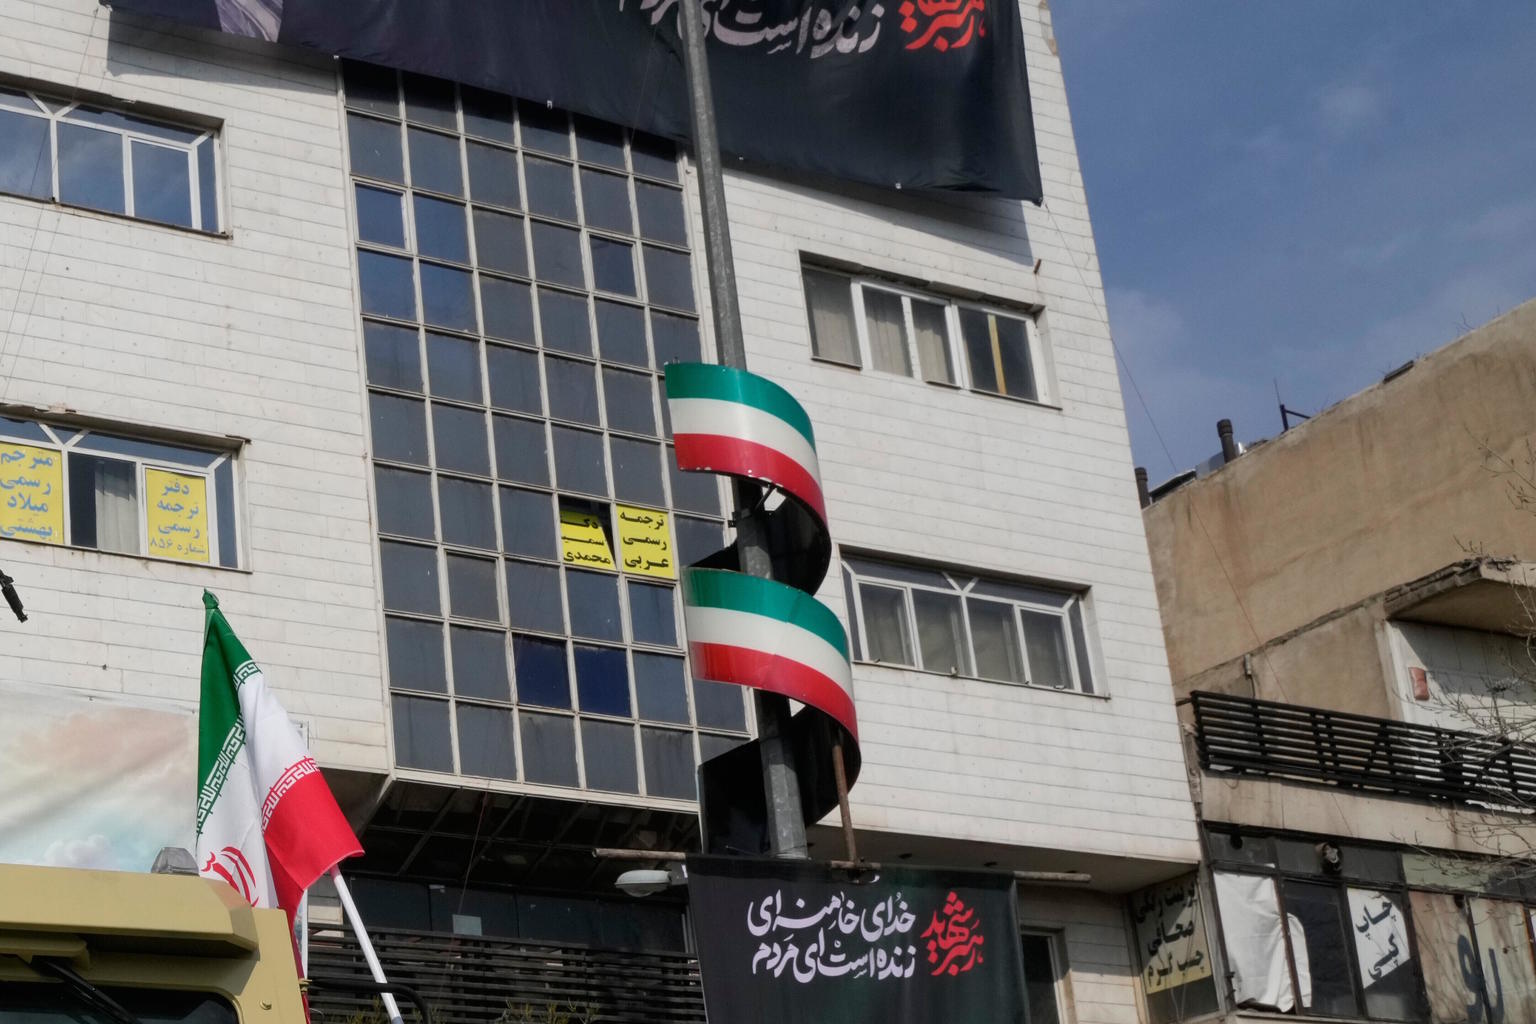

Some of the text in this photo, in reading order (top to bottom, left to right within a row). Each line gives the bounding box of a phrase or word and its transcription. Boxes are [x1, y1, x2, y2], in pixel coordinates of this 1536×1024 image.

[713, 3, 812, 55] است
[810, 2, 885, 58] زنده
[0, 449, 53, 469] مترجم
[0, 475, 52, 495] رسمی
[162, 478, 190, 497] دفتر
[7, 493, 49, 517] میلاد
[157, 500, 199, 519] ترجمه
[0, 517, 53, 541] بهشتی
[158, 521, 200, 539] رسمی
[620, 511, 664, 530] ترجمه
[176, 541, 206, 555] شماره
[623, 536, 667, 551] رسمی
[564, 551, 611, 565] محمدی
[625, 555, 669, 571] عربی
[861, 892, 916, 942] خدای
[1355, 901, 1397, 939] چاپ
[920, 891, 985, 976] رهبر شهید
[752, 927, 916, 984] زنده است ای مردم
[1368, 933, 1400, 981] کپی
